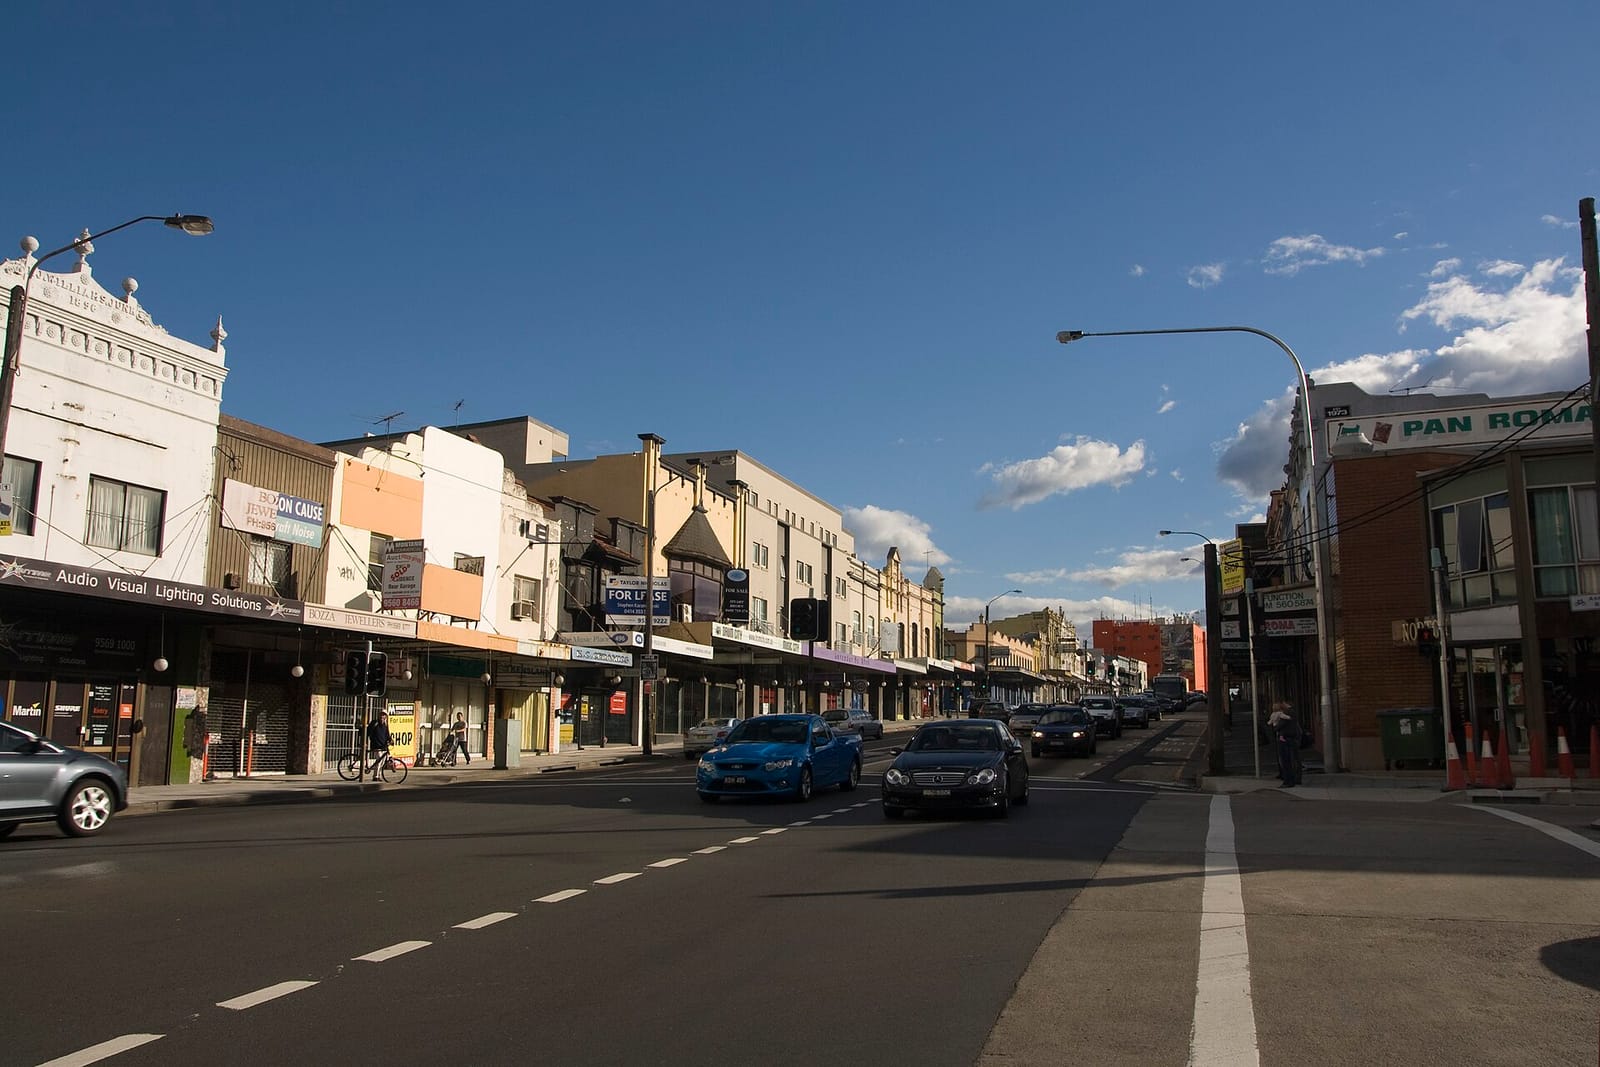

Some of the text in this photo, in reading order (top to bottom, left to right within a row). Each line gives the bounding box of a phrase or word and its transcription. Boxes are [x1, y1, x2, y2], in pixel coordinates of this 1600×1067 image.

[1403, 405, 1593, 436] PAN ROMA
[295, 501, 322, 521] CAUSE
[390, 566, 408, 582] SOLD
[56, 569, 98, 588] Audio
[107, 576, 147, 595] Visual
[155, 584, 204, 606] Lighting
[211, 594, 262, 612] Solutions
[609, 590, 632, 600] FOR
[309, 608, 336, 622] BOZZA
[345, 614, 385, 628] JEWELLERS
[12, 704, 41, 717] Martin
